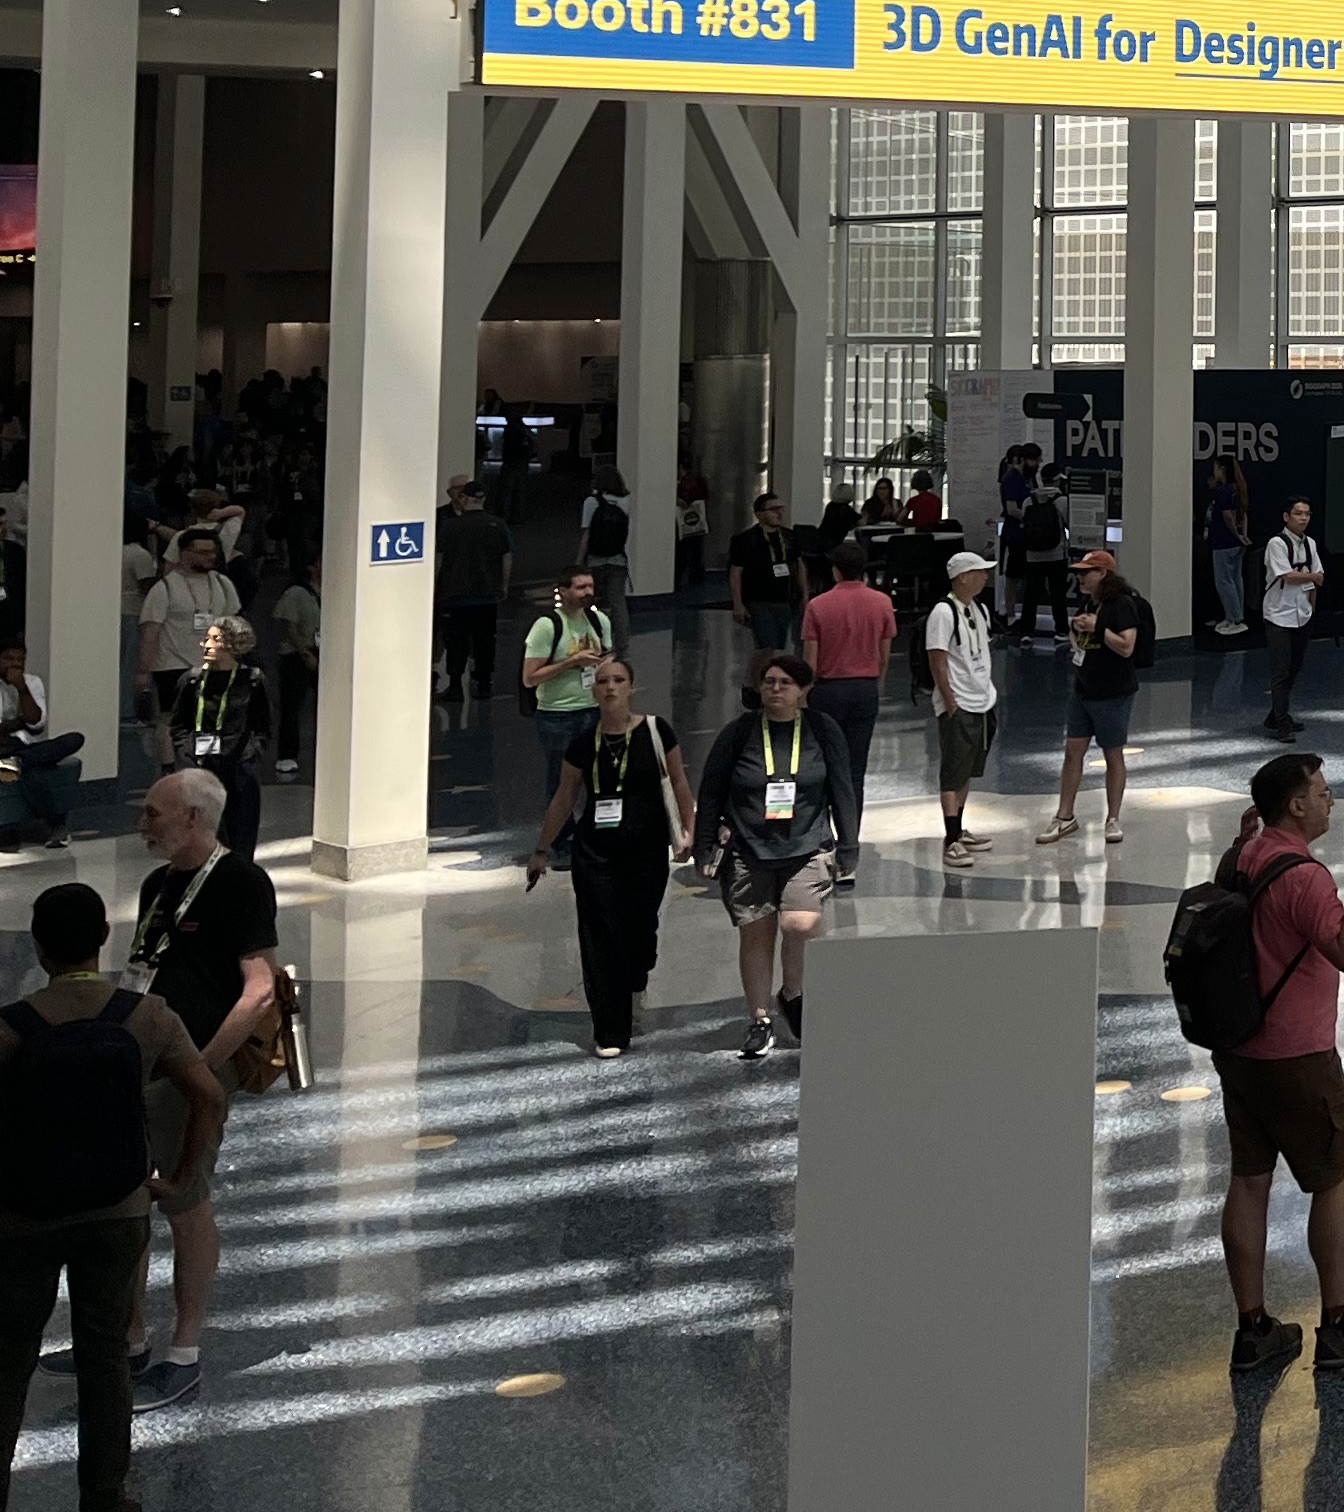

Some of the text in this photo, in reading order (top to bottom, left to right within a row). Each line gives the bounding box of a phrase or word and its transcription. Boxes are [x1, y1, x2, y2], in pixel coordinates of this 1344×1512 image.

[882, 3, 1343, 80] 3D GenAI for Designer
